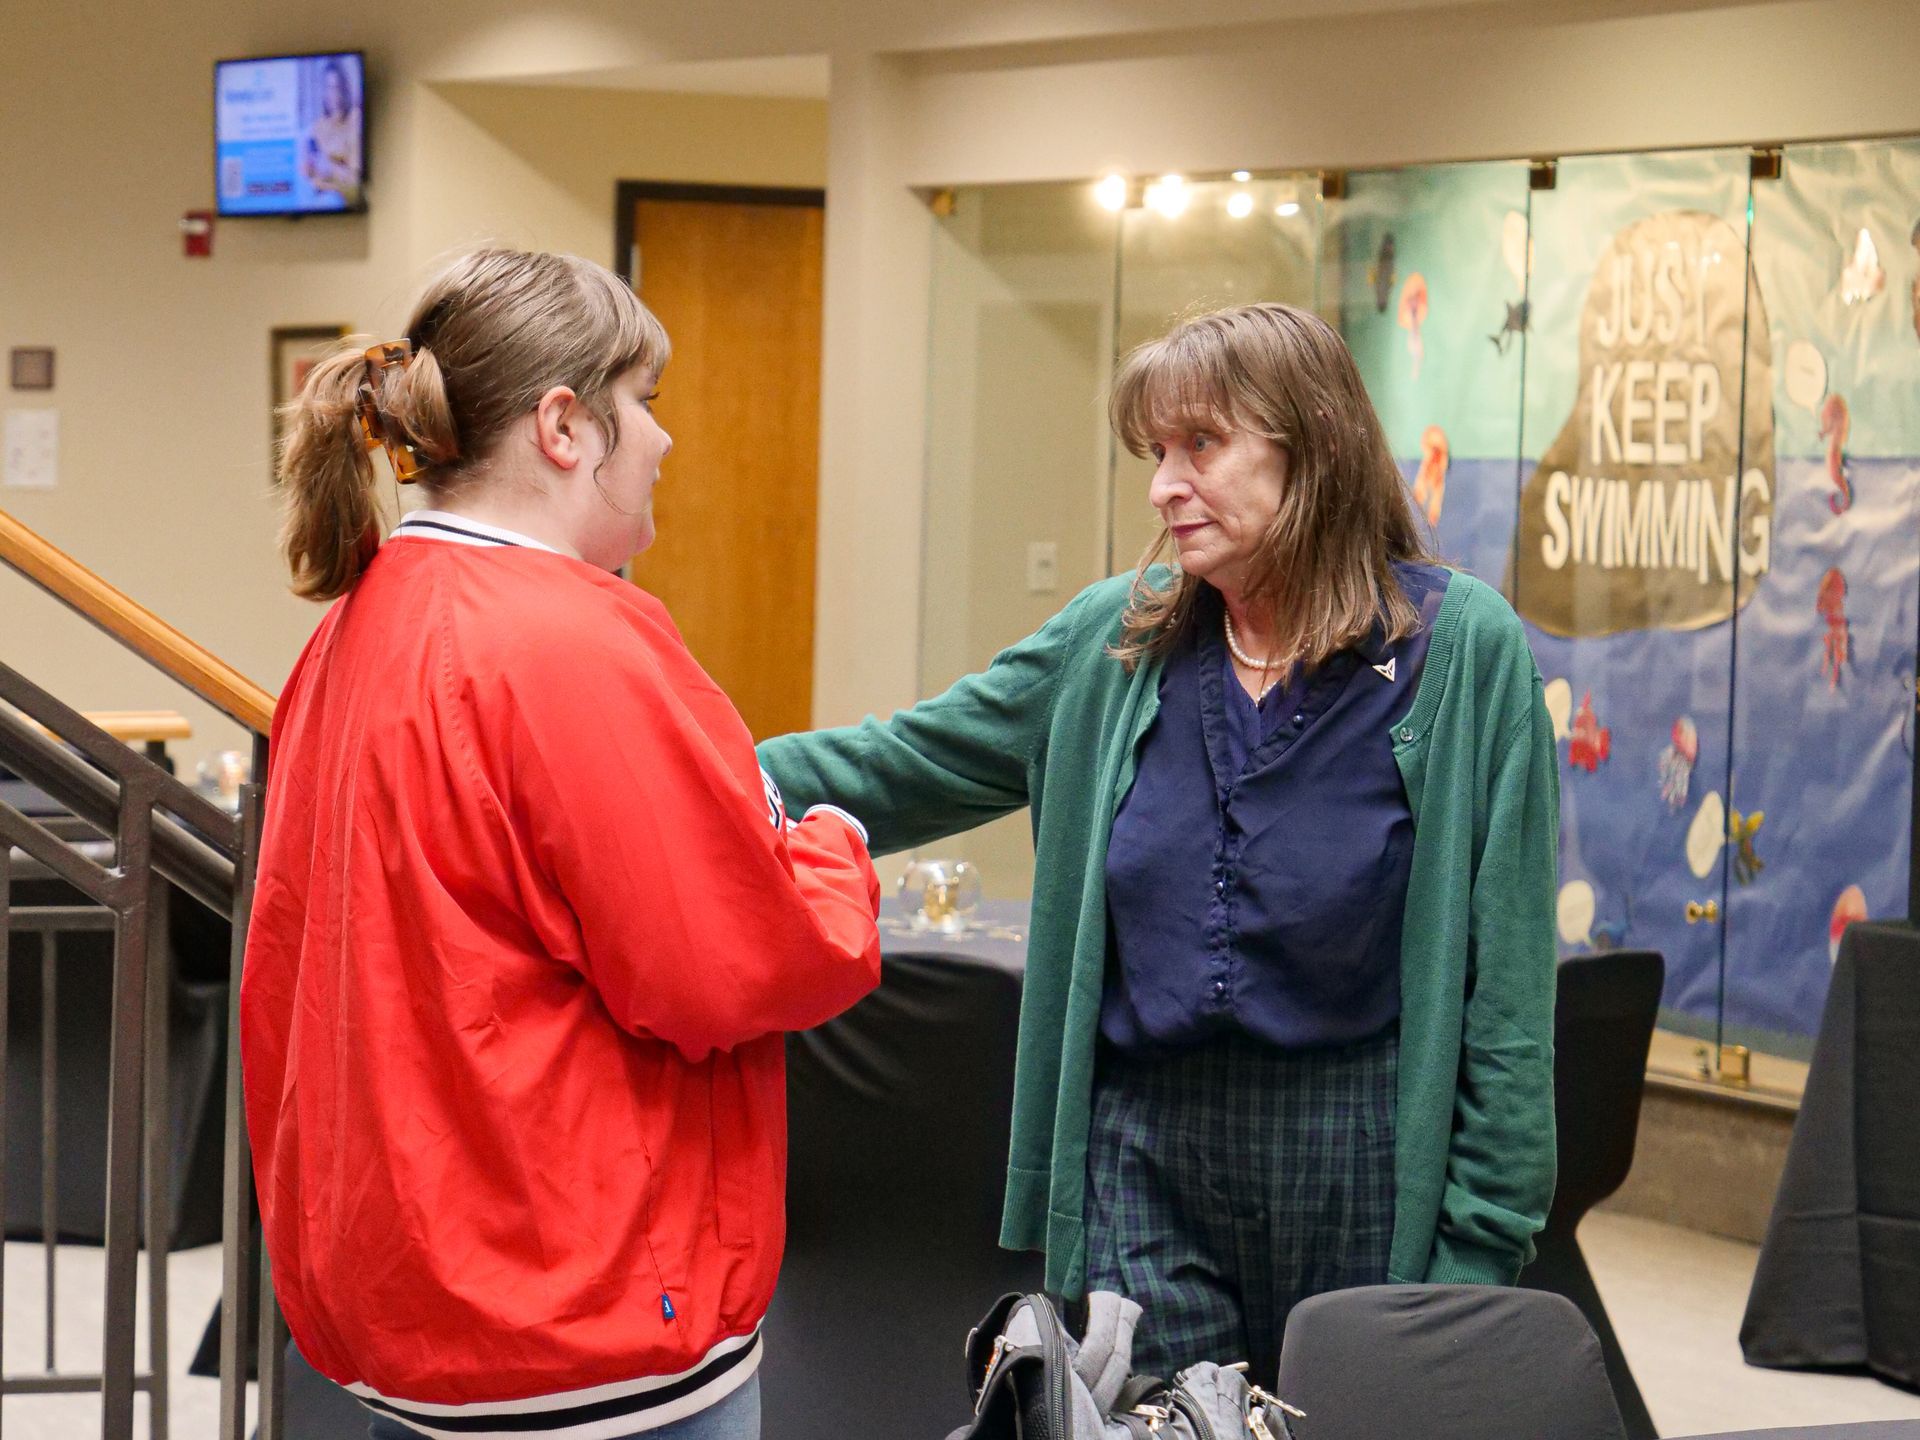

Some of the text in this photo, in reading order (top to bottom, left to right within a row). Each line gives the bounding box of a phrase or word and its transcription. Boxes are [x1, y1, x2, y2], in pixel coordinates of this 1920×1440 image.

[1597, 244, 1719, 348] JUST
[1592, 362, 1720, 465] KEEP
[1542, 469, 1770, 583] SWIMMING
